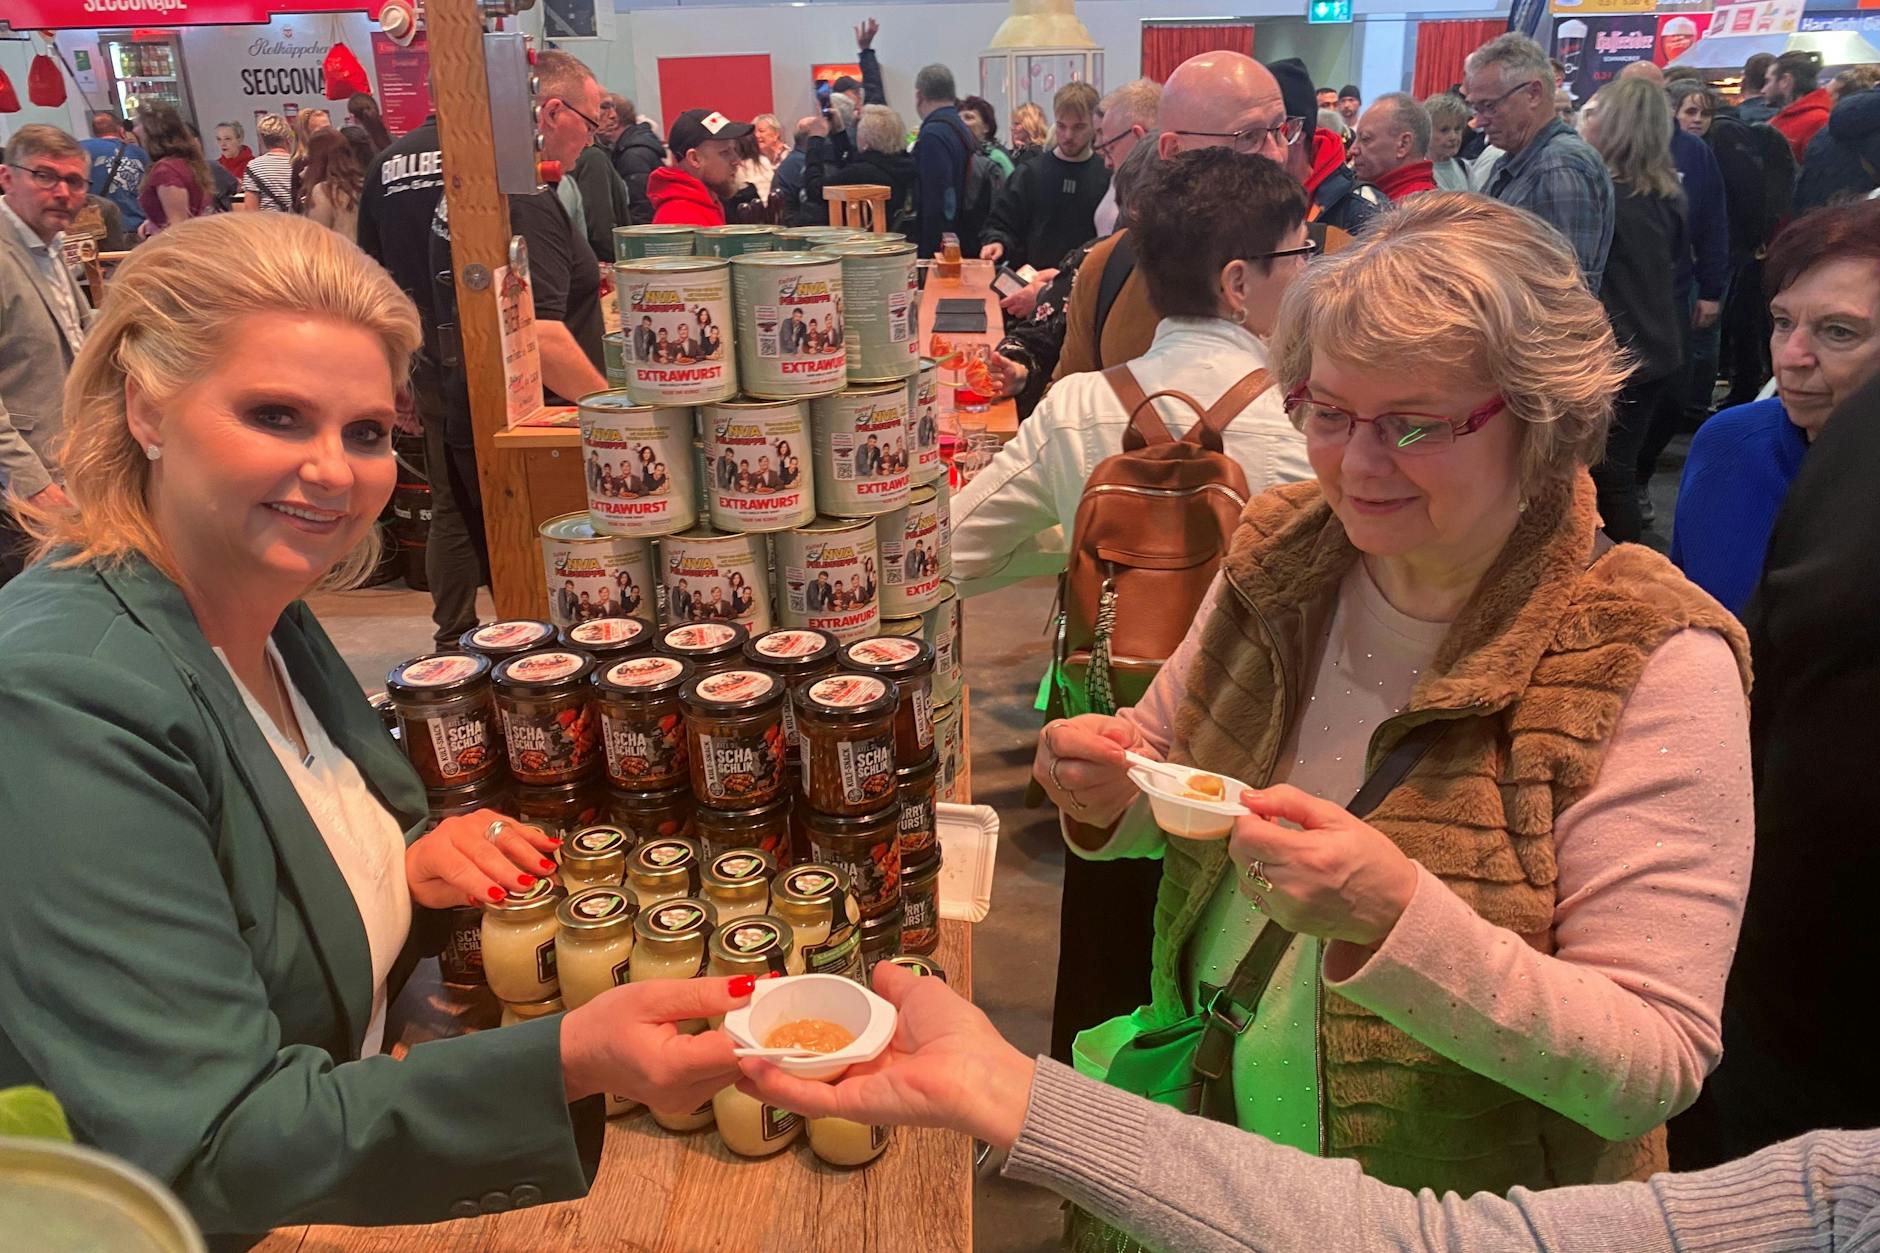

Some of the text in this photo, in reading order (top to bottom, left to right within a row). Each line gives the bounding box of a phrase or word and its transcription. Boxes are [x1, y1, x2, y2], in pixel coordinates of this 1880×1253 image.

[637, 366, 721, 381] EXTRAWURST
[719, 494, 799, 510] EXTRAWURST
[448, 720, 481, 741] SCHA
[512, 726, 544, 741] SCHA
[515, 740, 546, 750] SCHLIK
[613, 731, 647, 747] SCHA
[615, 745, 647, 756] SCHLIK
[716, 748, 753, 764] SCHA
[857, 746, 888, 768] SCHA
[718, 761, 753, 774] SCHLIK
